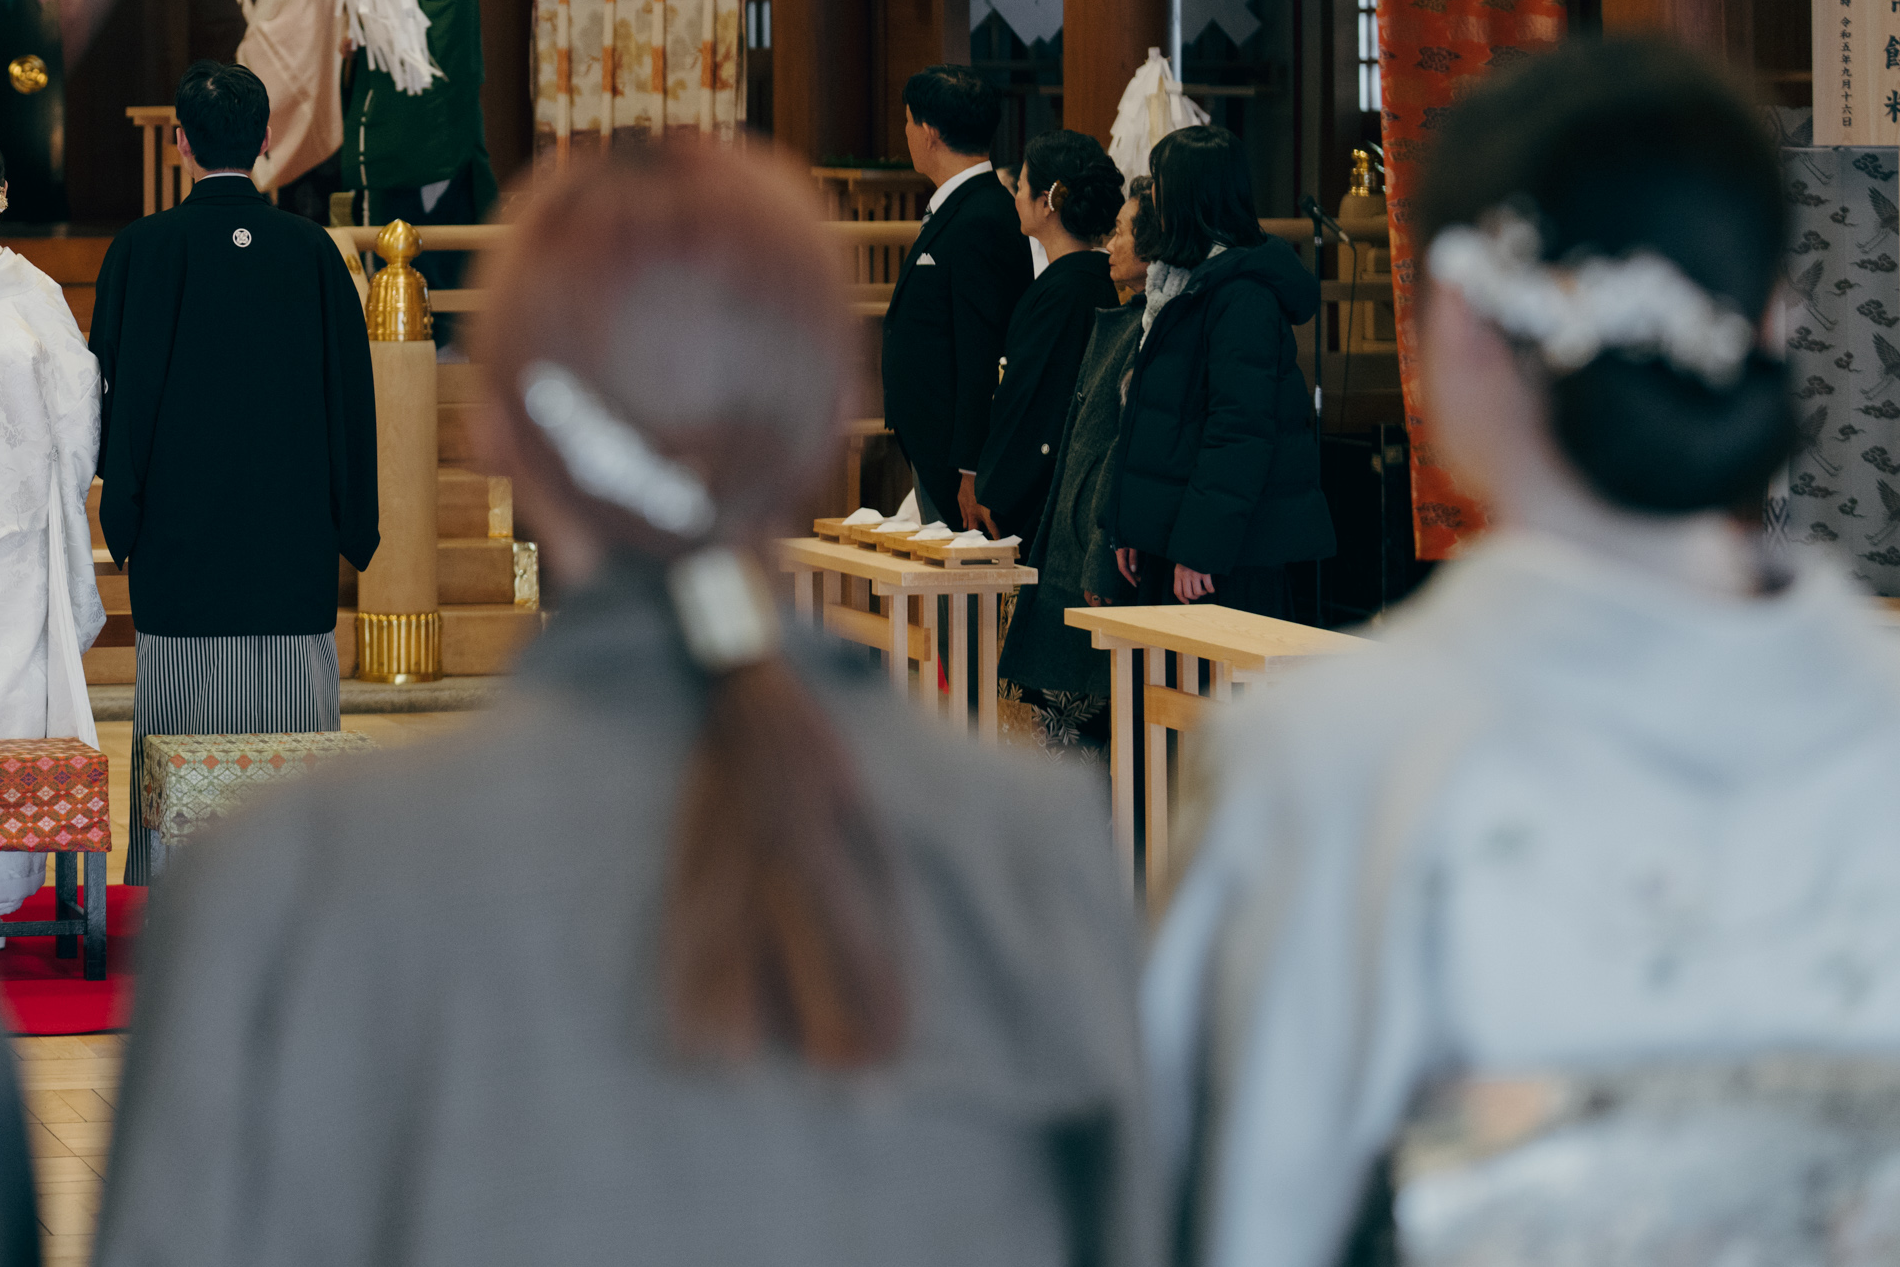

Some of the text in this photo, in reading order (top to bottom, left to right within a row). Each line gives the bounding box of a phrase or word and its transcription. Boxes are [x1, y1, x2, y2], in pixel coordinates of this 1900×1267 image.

[1840, 16, 1852, 127] 令和五年九月十六日
